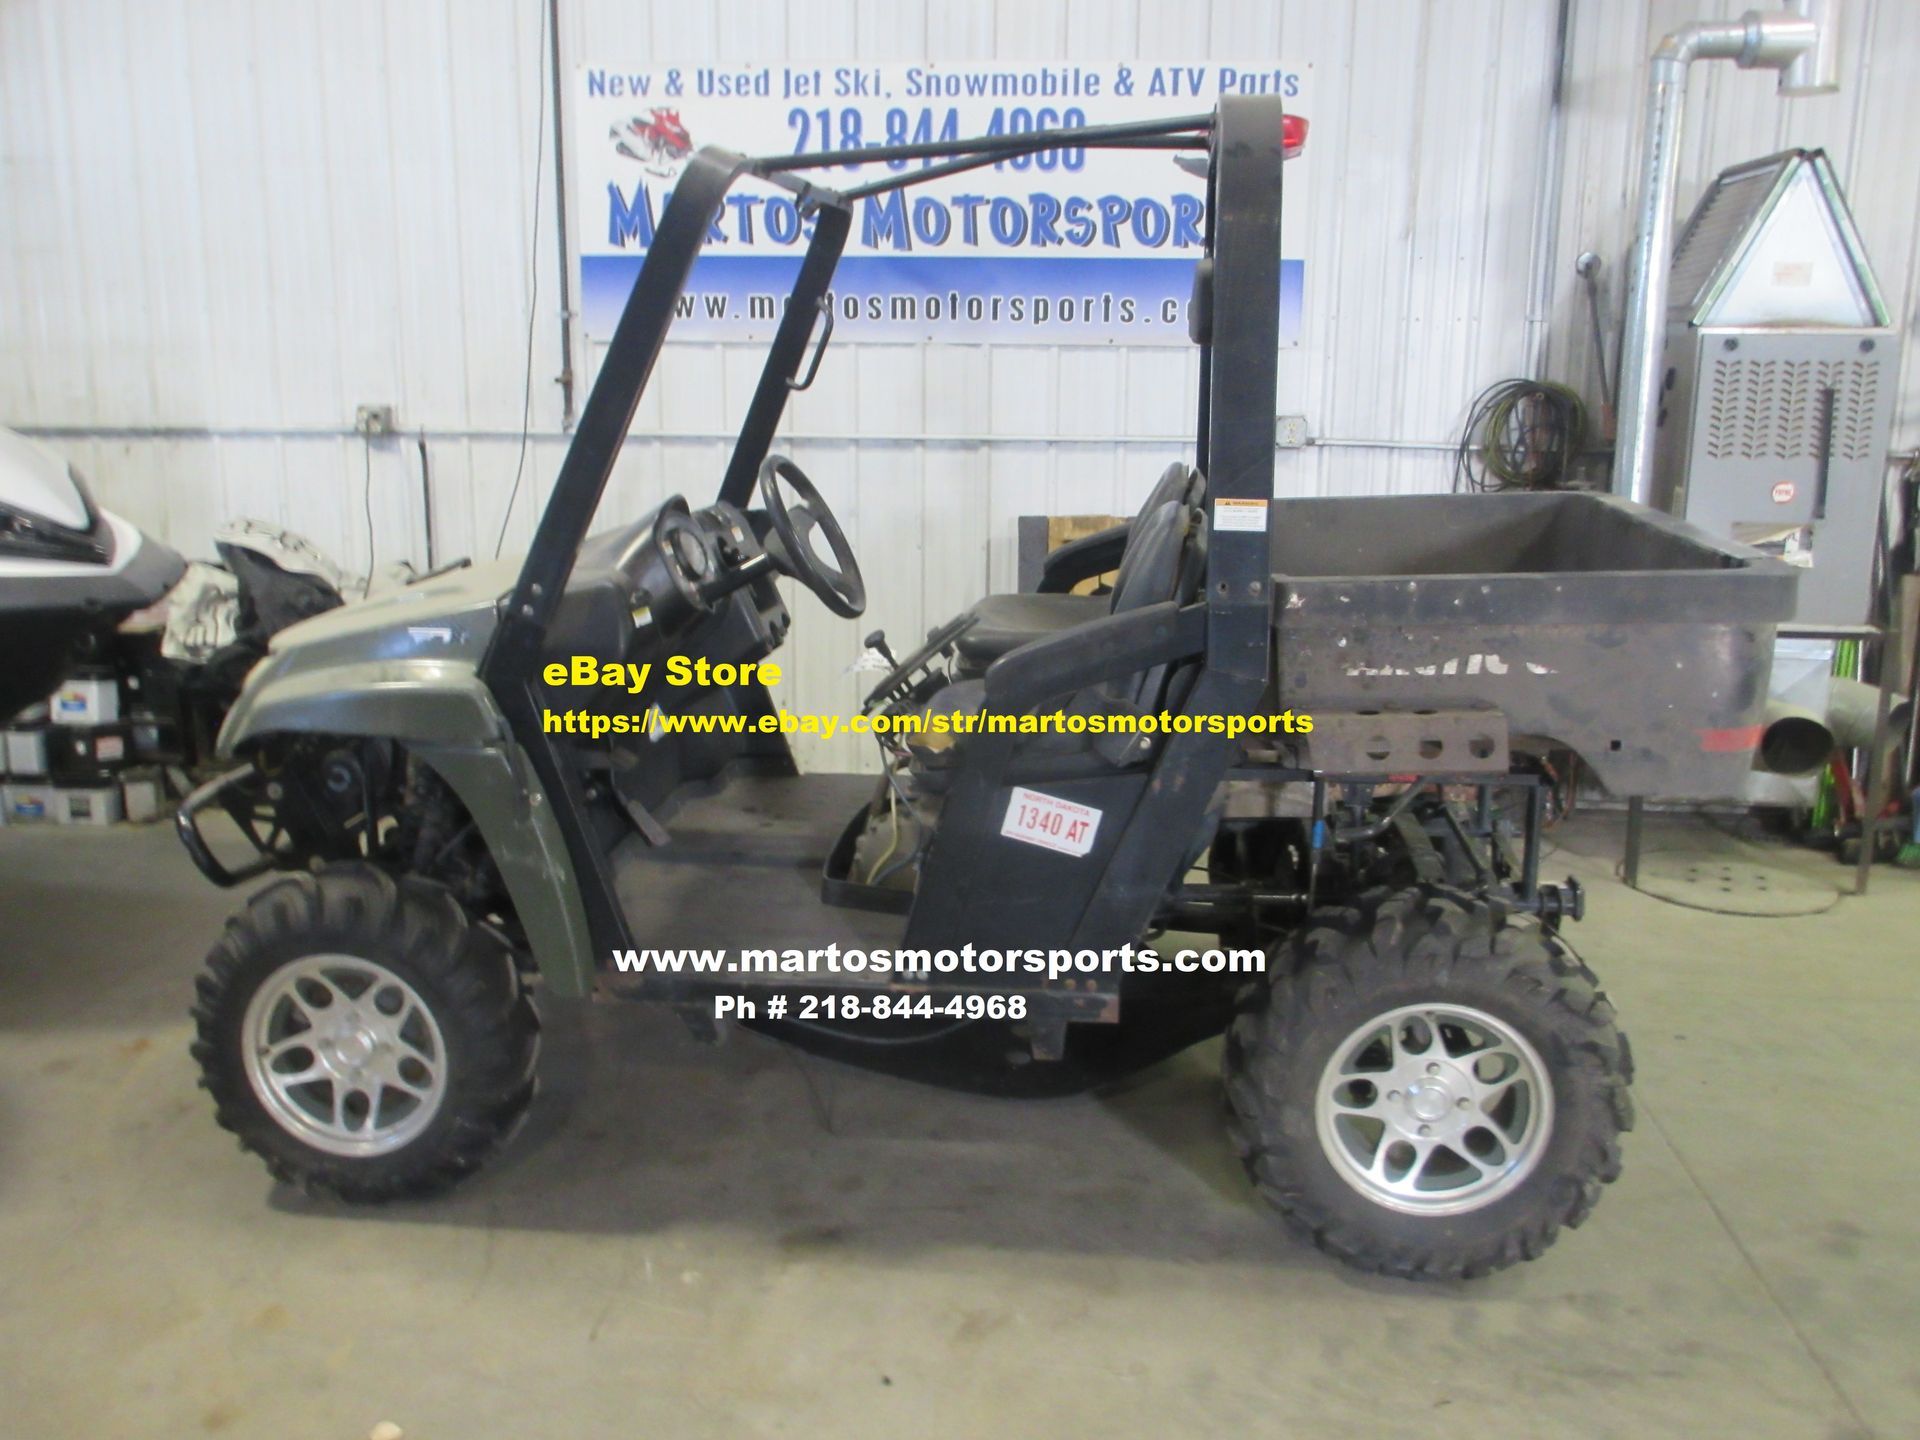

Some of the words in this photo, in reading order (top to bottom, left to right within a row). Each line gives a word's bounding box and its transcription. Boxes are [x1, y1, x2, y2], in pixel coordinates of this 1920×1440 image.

[588, 69, 651, 98] New
[664, 68, 684, 97] &
[697, 68, 770, 98] Used
[783, 68, 821, 99] Jet
[834, 68, 892, 99] Ski,
[906, 68, 1100, 98] Snowmobile
[1114, 67, 1134, 97] &
[1148, 67, 1206, 97] ATV
[1219, 67, 1299, 97] Parts
[787, 107, 1087, 172] 218-8444060
[1018, 804, 1063, 836] 1340
[1065, 819, 1090, 844] AT
